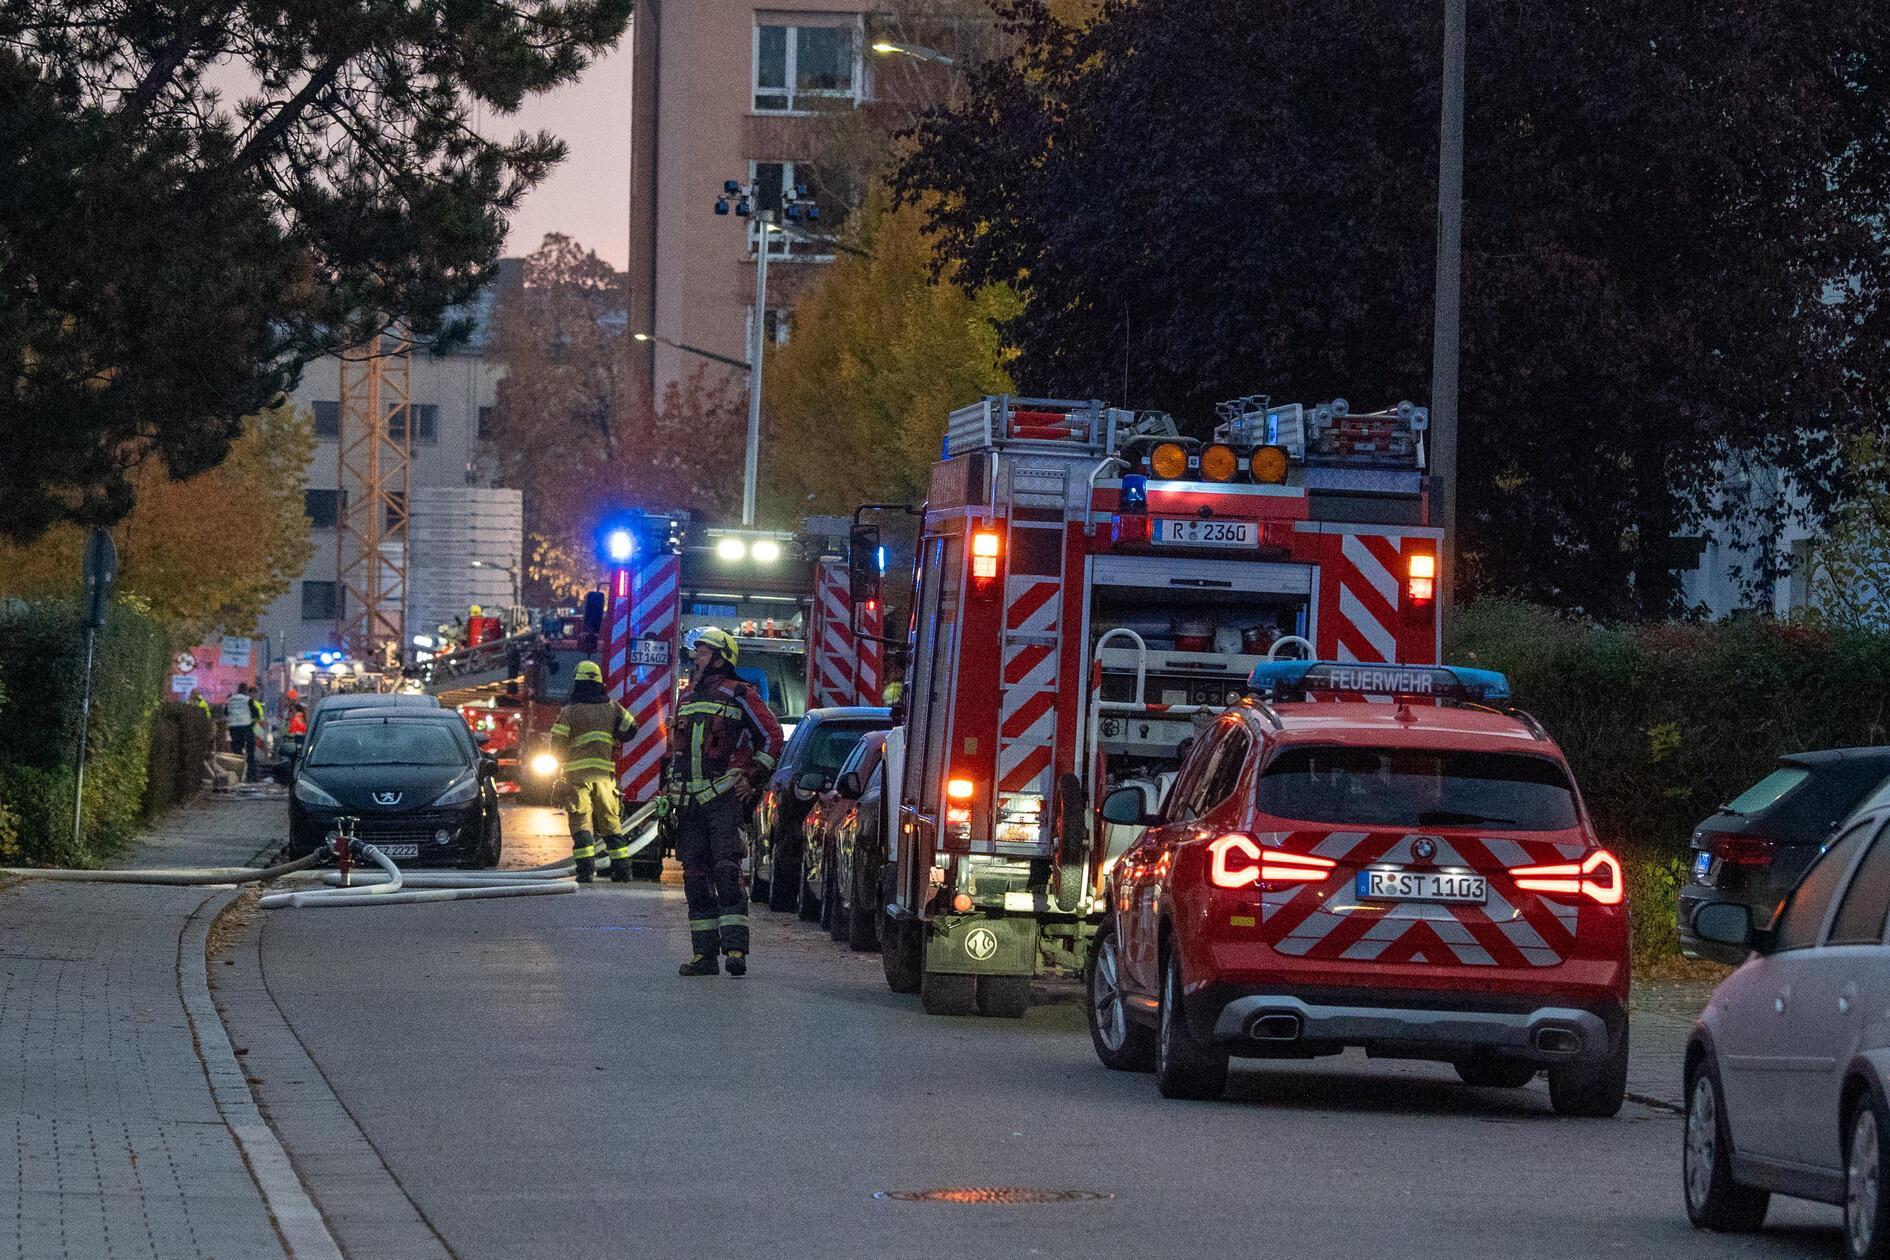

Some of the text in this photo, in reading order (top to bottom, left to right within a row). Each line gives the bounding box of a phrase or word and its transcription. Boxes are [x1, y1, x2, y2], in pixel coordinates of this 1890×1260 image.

[1173, 522, 1246, 541] R 2360
[644, 642, 651, 652] R
[632, 652, 643, 662] ST
[1330, 669, 1432, 693] FEUERWEHR
[392, 846, 416, 856] 2222
[1371, 875, 1484, 898] R ST 1103
